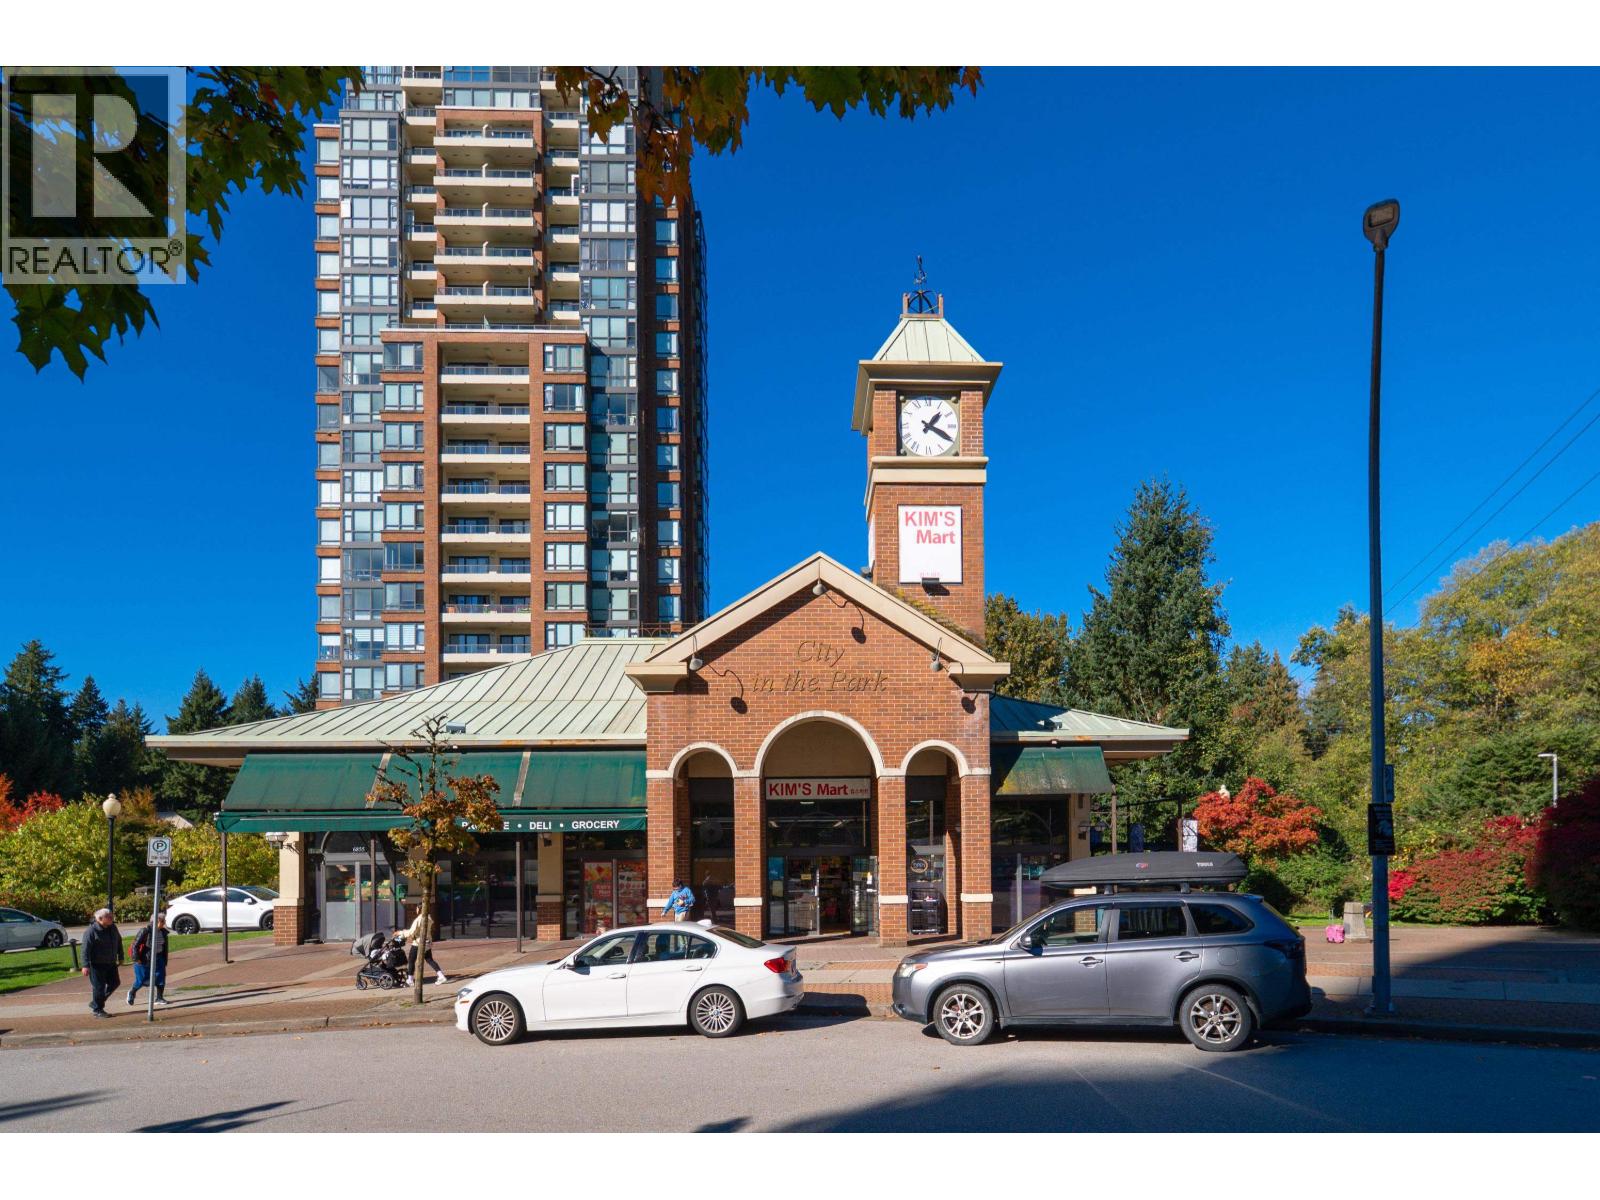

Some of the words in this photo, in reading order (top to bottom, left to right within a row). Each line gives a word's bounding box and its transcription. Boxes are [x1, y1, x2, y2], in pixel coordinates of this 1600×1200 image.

[905, 511, 956, 527] KIM'S
[916, 529, 956, 545] Mart
[797, 640, 846, 668] City
[752, 673, 775, 692] in
[784, 671, 821, 692] the
[826, 670, 889, 692] Park
[768, 783, 812, 796] KIM'S
[817, 784, 849, 796] Mart
[529, 821, 552, 830] DELI
[571, 820, 620, 830] GROCERY
